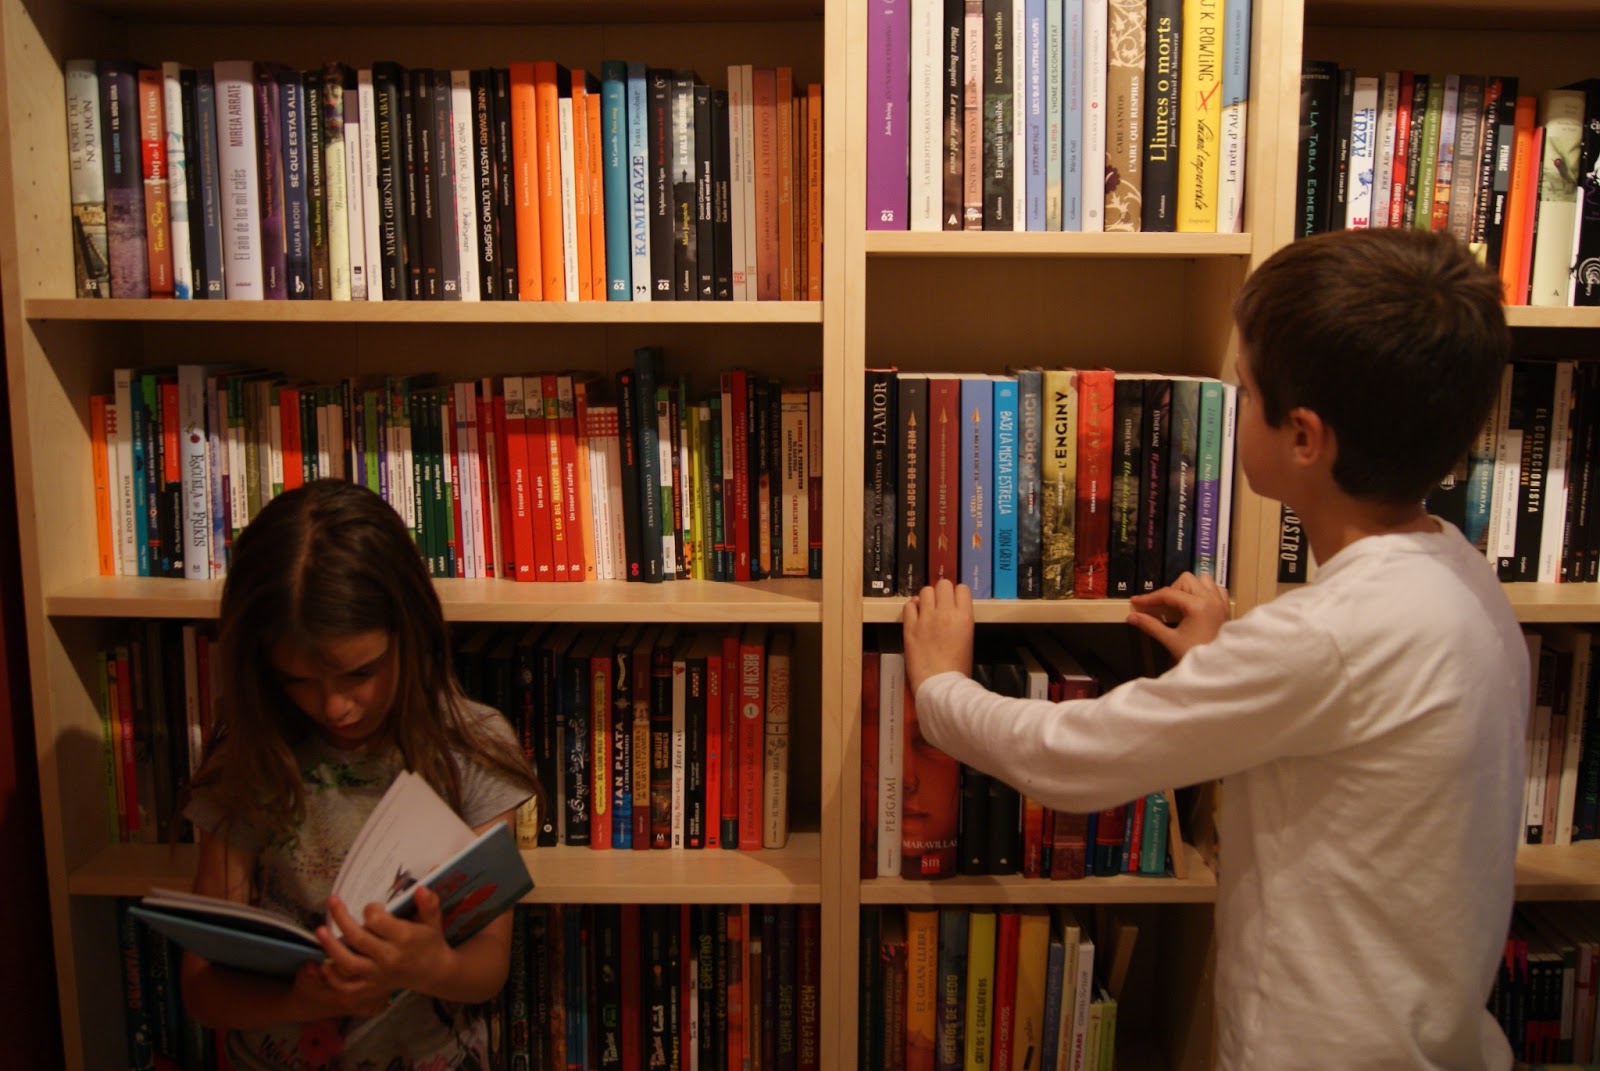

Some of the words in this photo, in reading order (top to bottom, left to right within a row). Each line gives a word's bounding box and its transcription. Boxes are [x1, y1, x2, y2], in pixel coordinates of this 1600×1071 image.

[951, 27, 959, 52] Blanca
[995, 12, 1003, 50] Redondo
[1156, 18, 1170, 74] morts
[1198, 28, 1215, 82] ROWLING
[949, 54, 959, 87] Busquets
[995, 52, 1003, 83] Dolores
[287, 84, 296, 108] ALLÍ
[951, 94, 959, 105] La
[1130, 76, 1138, 118] RESPIRES
[1158, 80, 1169, 92] o
[70, 96, 79, 116] DEL
[228, 85, 241, 115] ARRATE
[379, 91, 389, 117] ABAT
[633, 92, 641, 125] Escobar
[885, 103, 893, 120] Irving
[1116, 95, 1124, 128] SANTOS
[79, 100, 94, 129] MÓN
[286, 110, 297, 145] ESTÁS
[951, 107, 959, 134] nevada
[995, 101, 1003, 134] invisible
[1227, 97, 1239, 139] d'Adam
[1309, 112, 1318, 127] LA
[70, 122, 80, 152] PORT
[146, 122, 158, 147] Lola
[229, 118, 243, 146] MIREIA
[633, 129, 641, 147] Iván
[1129, 121, 1138, 140] QUE
[1150, 98, 1168, 161] Lliures
[1352, 108, 1368, 157] AZUL
[1459, 107, 1477, 155] WATSON
[1485, 129, 1493, 151] CUIDA
[83, 132, 96, 162] NOU
[679, 134, 687, 153] FALS
[951, 137, 959, 150] del
[995, 136, 1006, 168] guardià
[1226, 144, 1238, 166] néta
[1308, 133, 1318, 171] TABLA
[71, 158, 81, 170] EL
[290, 149, 298, 170] QUE
[480, 147, 489, 175] HASTA
[680, 155, 688, 165] EL
[951, 153, 959, 174] cucut
[1129, 143, 1137, 172] L'AIRE
[1484, 154, 1491, 163] DE
[1498, 145, 1509, 172] PENNAC
[149, 160, 161, 184] blog
[231, 169, 246, 190] cafés
[289, 173, 299, 187] SÉ
[481, 178, 489, 189] EL
[996, 170, 1003, 178] El
[1190, 154, 1209, 210] imprevista
[1227, 171, 1236, 182] La
[233, 193, 246, 205] mil
[313, 185, 321, 196] EL
[383, 166, 394, 218] GIRONELL
[1422, 187, 1430, 214] Gabriele
[151, 200, 166, 227] Roig
[234, 208, 247, 219] los
[481, 192, 492, 220] ÚLTIMO
[633, 156, 646, 256] KAMIKAZE
[234, 223, 248, 231] de
[384, 221, 395, 256] MARTÍ
[235, 235, 249, 249] año
[484, 223, 493, 261] SUSPIRO
[873, 382, 887, 444] L'AMOR
[999, 411, 1013, 431] BAJO
[1153, 410, 1161, 431] ESTHER
[1536, 408, 1547, 418] EL
[999, 433, 1013, 445] LA
[1024, 393, 1037, 463] PRODIGI
[1056, 391, 1067, 468] L'ENGINY
[1124, 419, 1132, 440] ESTHER
[1152, 432, 1161, 448] SANZ
[1123, 441, 1131, 456] SANZ
[1524, 435, 1533, 453] PAUL
[999, 446, 1013, 473] MISMA
[1521, 457, 1531, 486] CLEAVE
[1528, 426, 1546, 513] COLECCIONISTA
[999, 476, 1013, 515] ESTRELLA
[1479, 471, 1488, 514] DESPERTAR
[999, 529, 1013, 546] JOHN
[999, 549, 1013, 571] GREEN
[746, 685, 759, 698] JO
[615, 722, 623, 770] PLATA
[615, 776, 623, 807] JAN
[922, 858, 940, 867] sm
[917, 928, 926, 962] LLIBRE
[916, 966, 925, 997] GRAN
[946, 975, 958, 1004] MIEDO
[946, 1008, 957, 1019] DE
